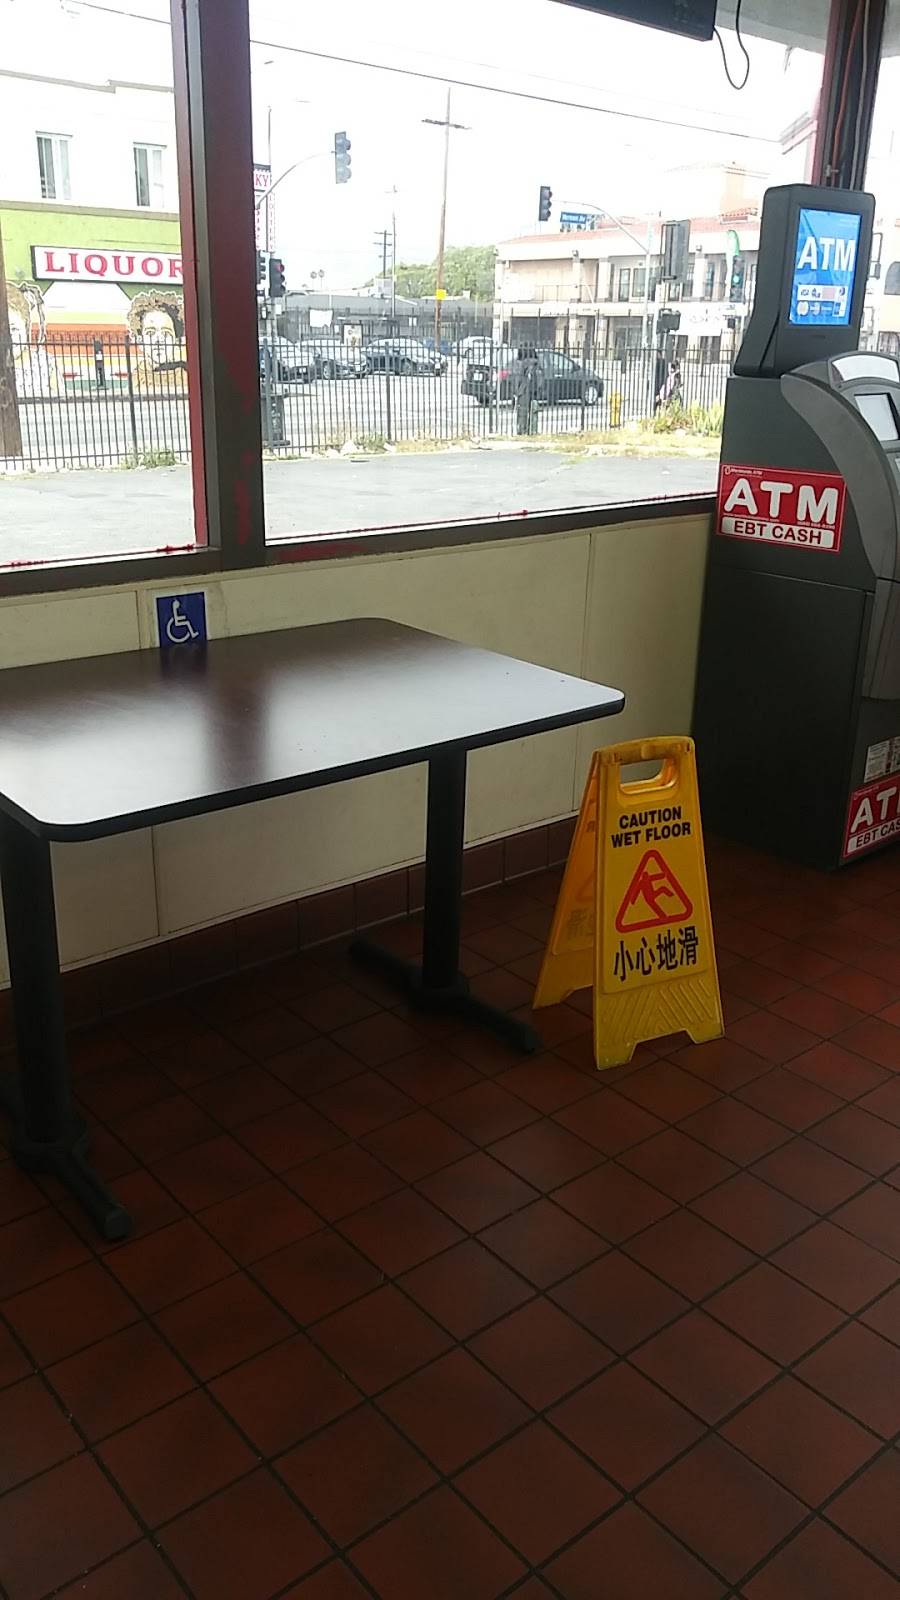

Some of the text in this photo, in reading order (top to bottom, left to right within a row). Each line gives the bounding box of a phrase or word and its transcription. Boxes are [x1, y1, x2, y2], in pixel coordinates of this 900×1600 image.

[44, 251, 183, 277] LIQUOR
[797, 236, 856, 272] ATM
[723, 478, 839, 525] ATM
[734, 520, 822, 545] EBT CASH
[619, 806, 682, 829] CAUTION
[850, 786, 900, 833] AT
[611, 822, 691, 848] WET FLOOR
[856, 829, 879, 847] EBT
[613, 926, 699, 982] 小心地滑
